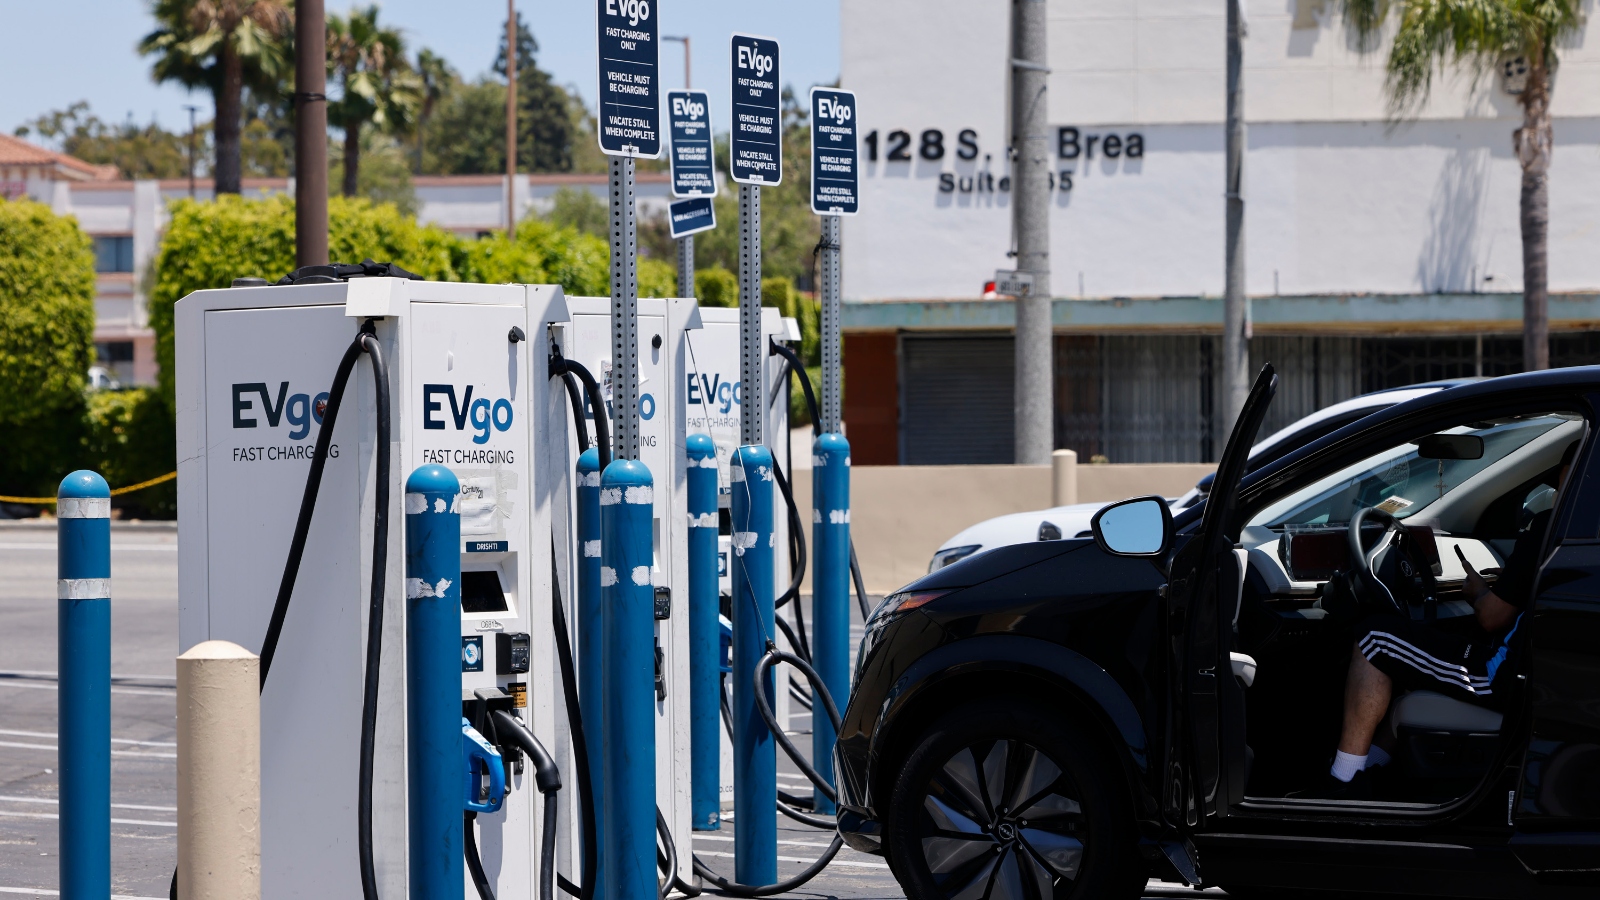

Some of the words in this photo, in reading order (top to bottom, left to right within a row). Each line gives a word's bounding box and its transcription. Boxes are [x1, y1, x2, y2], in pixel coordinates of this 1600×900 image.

[606, 0, 649, 26] EVgo
[606, 27, 620, 37] FAST
[621, 29, 650, 41] CHARGING
[620, 40, 636, 50] ONLY
[738, 45, 773, 77] EVgo
[607, 71, 632, 83] VEHICLE
[634, 74, 650, 84] MUST
[738, 77, 749, 86] FAST
[750, 79, 773, 89] CHARGING
[609, 83, 617, 92] BE
[618, 84, 649, 96] CHARGING
[749, 88, 762, 97] ONLY
[673, 98, 704, 120] EVgo
[818, 98, 851, 125] EVgo
[609, 116, 632, 126] VACATE
[633, 118, 650, 129] STALL
[739, 113, 759, 123] VEHICLE
[760, 116, 773, 125] MUST
[605, 127, 623, 137] WHEN
[624, 129, 655, 140] COMPLETE
[740, 123, 746, 131] BE
[747, 124, 772, 134] CHARGING
[819, 125, 830, 133] FAST
[830, 126, 852, 135] CHARGING
[864, 129, 945, 161] 128
[957, 129, 991, 161] S.
[1059, 127, 1144, 159] Brea
[740, 150, 758, 159] VACATE
[759, 152, 773, 161] STALL
[819, 155, 839, 164] VEHICLE
[840, 157, 852, 165] MUST
[736, 159, 750, 168] WHEN
[751, 160, 776, 170] COMPLETE
[821, 163, 827, 171] BE
[828, 164, 851, 173] CHARGING
[939, 172, 1010, 193] Suite
[820, 186, 838, 195] VACATE
[839, 187, 852, 196] STALL
[817, 194, 831, 202] WHEN
[832, 195, 855, 204] COMPLETE
[423, 383, 513, 445] EVgo
[687, 417, 705, 428] FAST
[708, 417, 741, 428] CHARGIN
[233, 447, 264, 461] FAST
[267, 444, 339, 460] CHARGG
[423, 449, 451, 464] FAST
[454, 449, 514, 464] CHARGING
